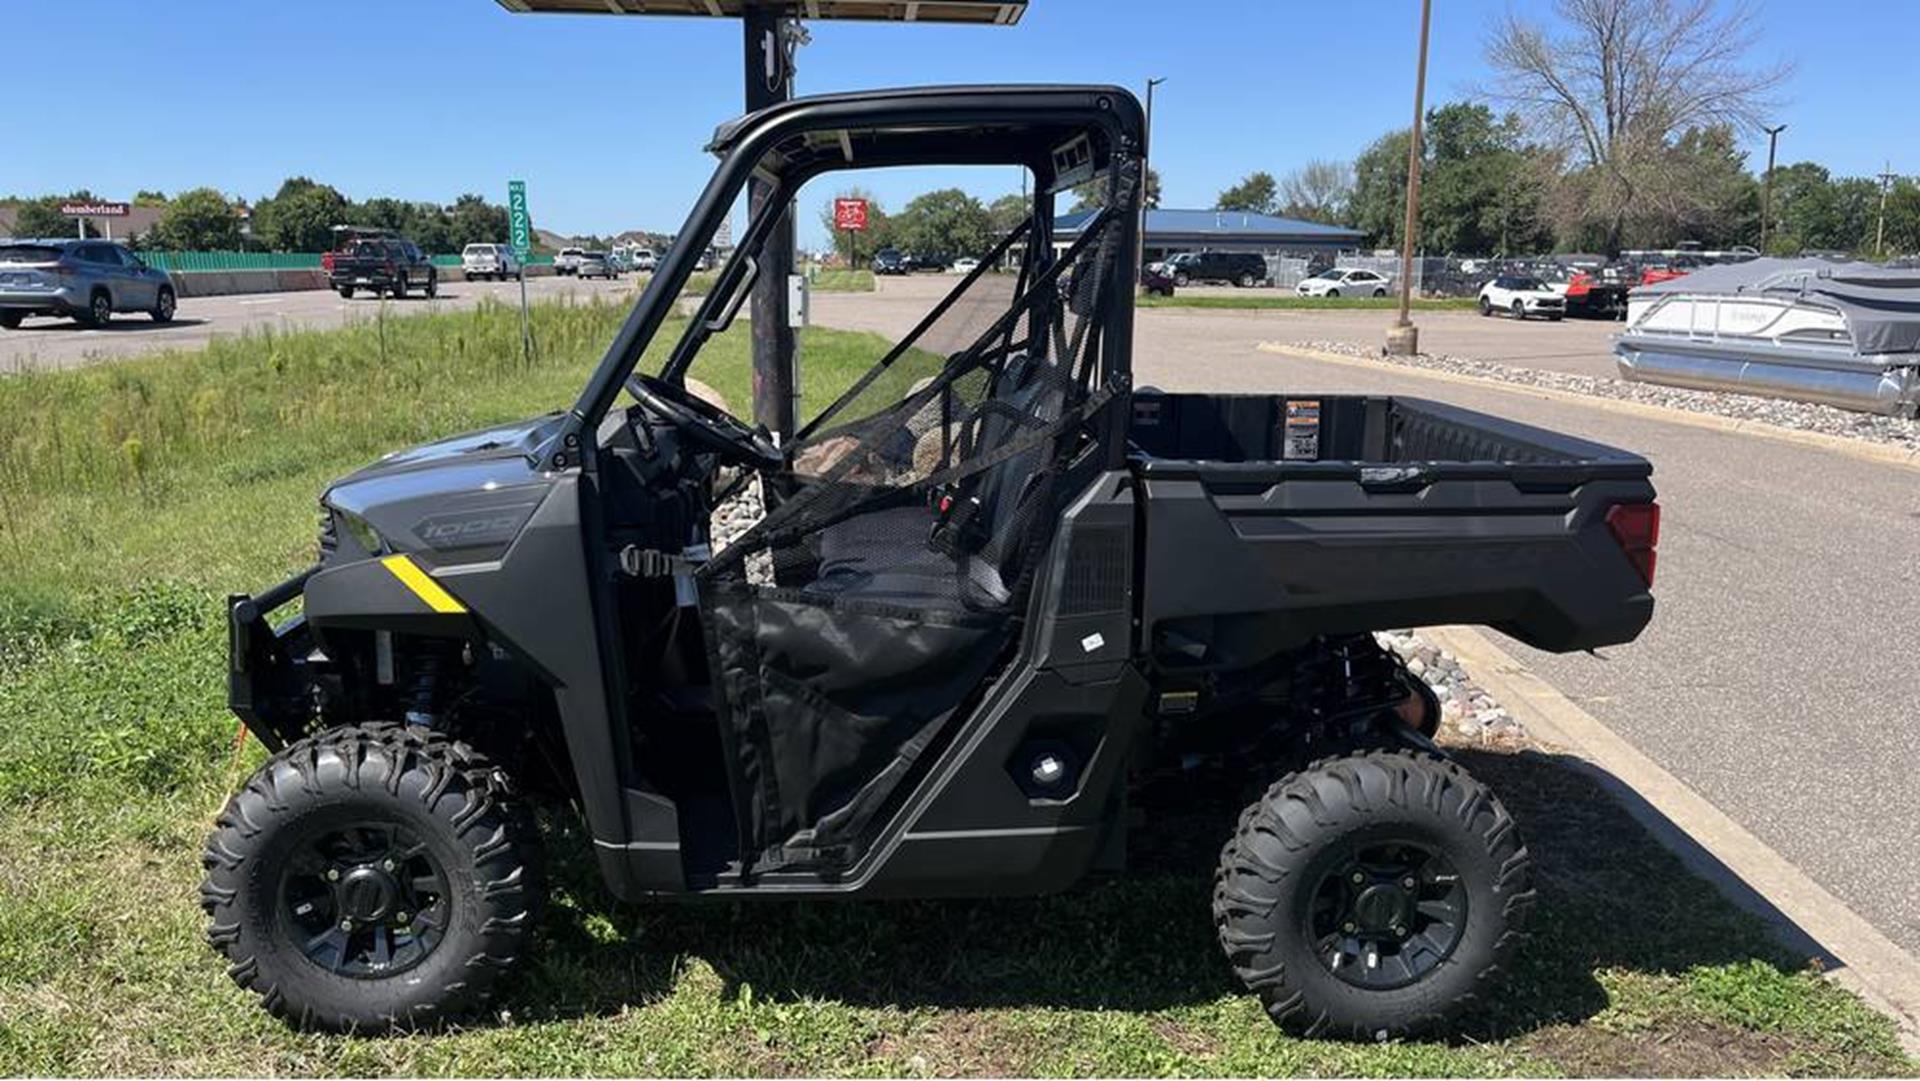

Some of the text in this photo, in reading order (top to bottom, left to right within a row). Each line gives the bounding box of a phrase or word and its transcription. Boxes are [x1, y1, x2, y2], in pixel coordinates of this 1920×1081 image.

[62, 203, 124, 214] slumberland
[513, 194, 525, 246] 222
[423, 516, 519, 538] 1000
